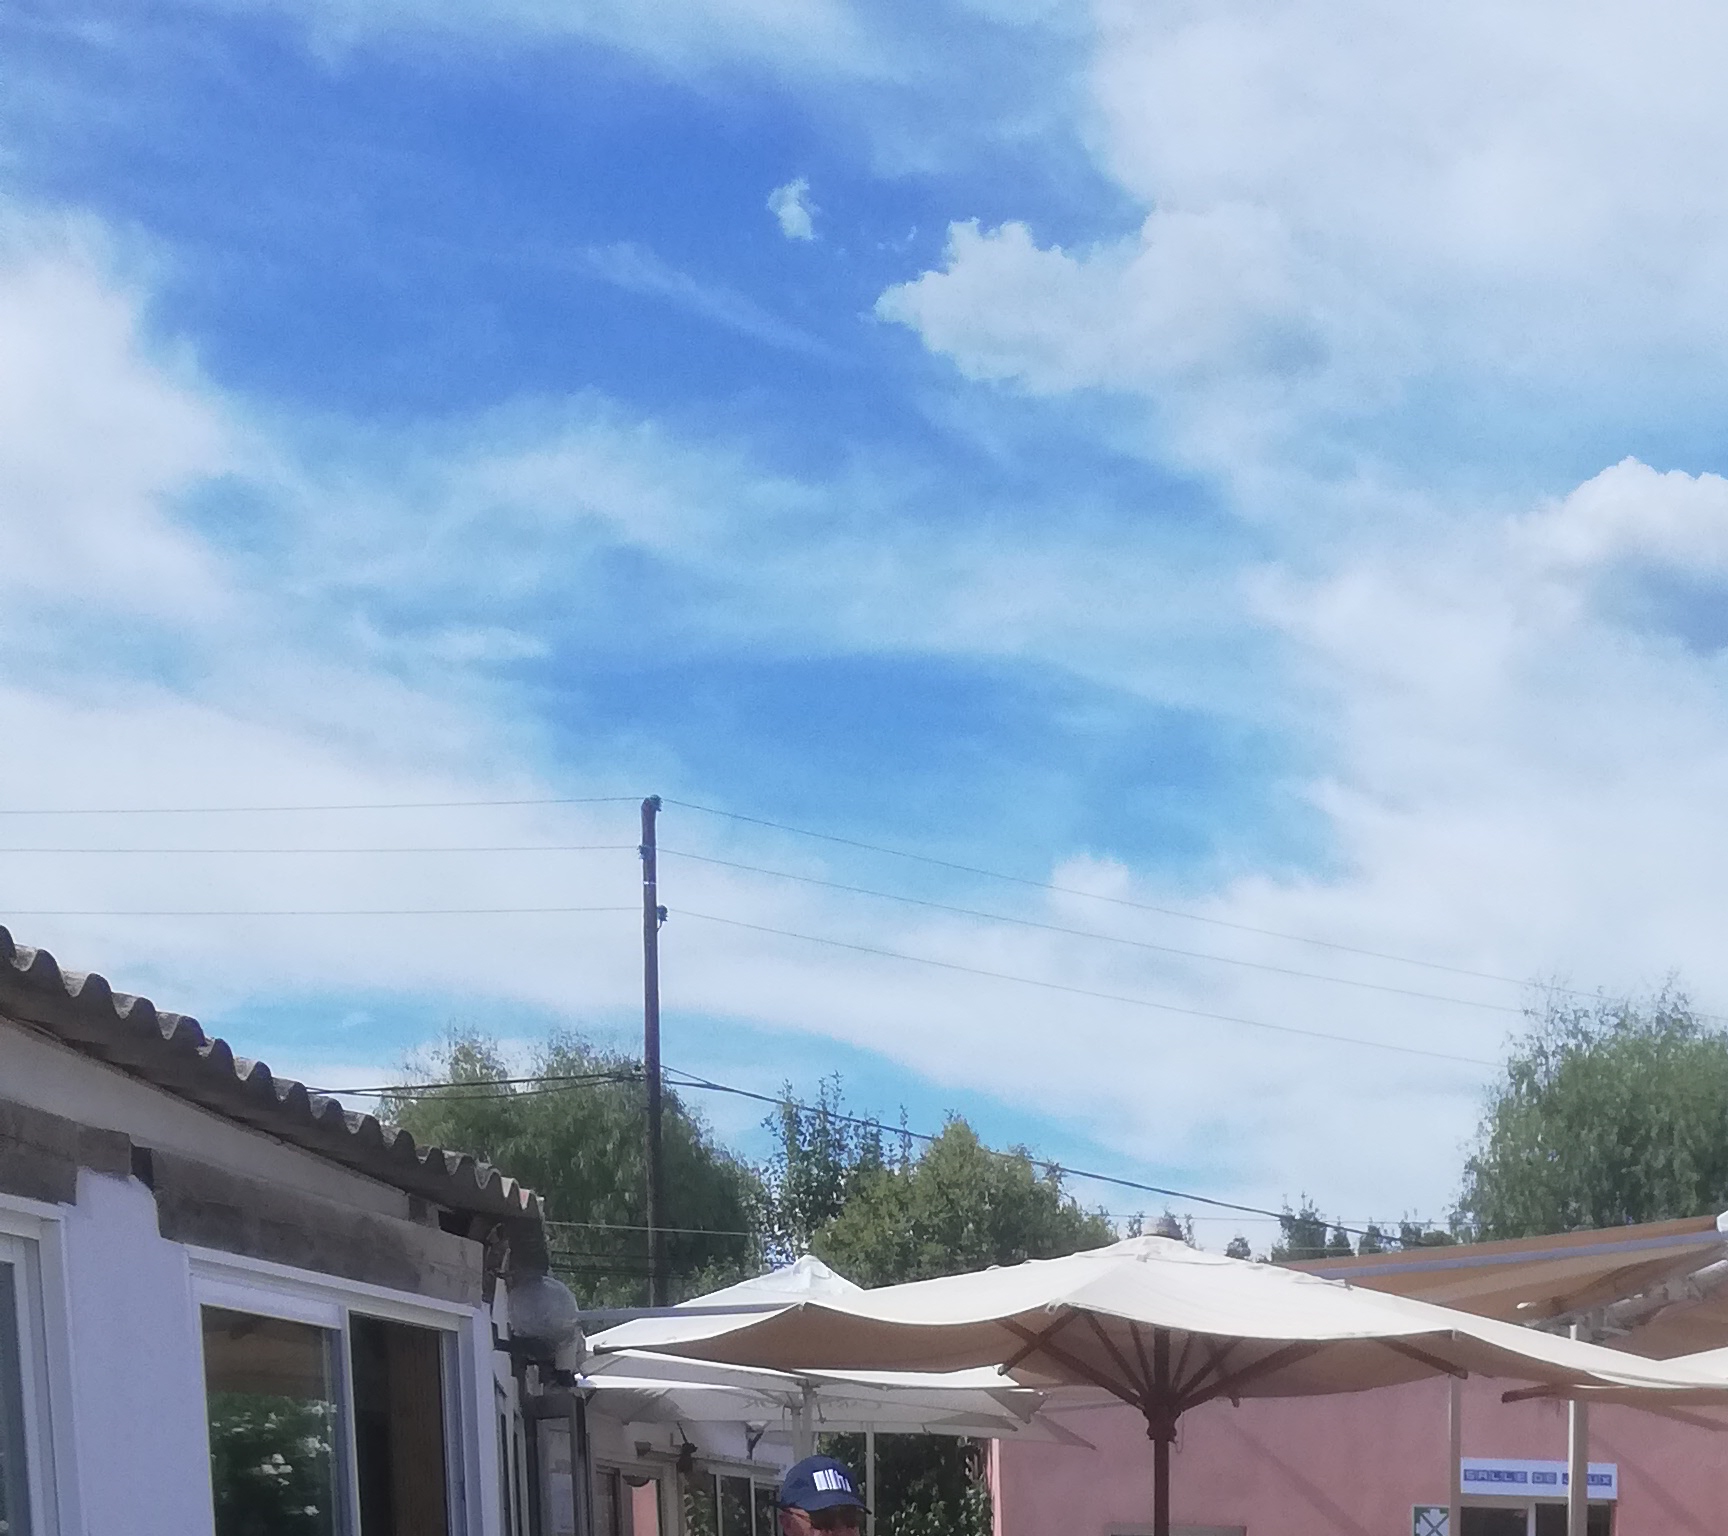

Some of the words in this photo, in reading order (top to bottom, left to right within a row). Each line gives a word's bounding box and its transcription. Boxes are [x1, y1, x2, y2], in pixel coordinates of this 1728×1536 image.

[1464, 1470, 1527, 1483] SALLE
[1533, 1472, 1556, 1484] DE
[1562, 1473, 1612, 1486] JUX
